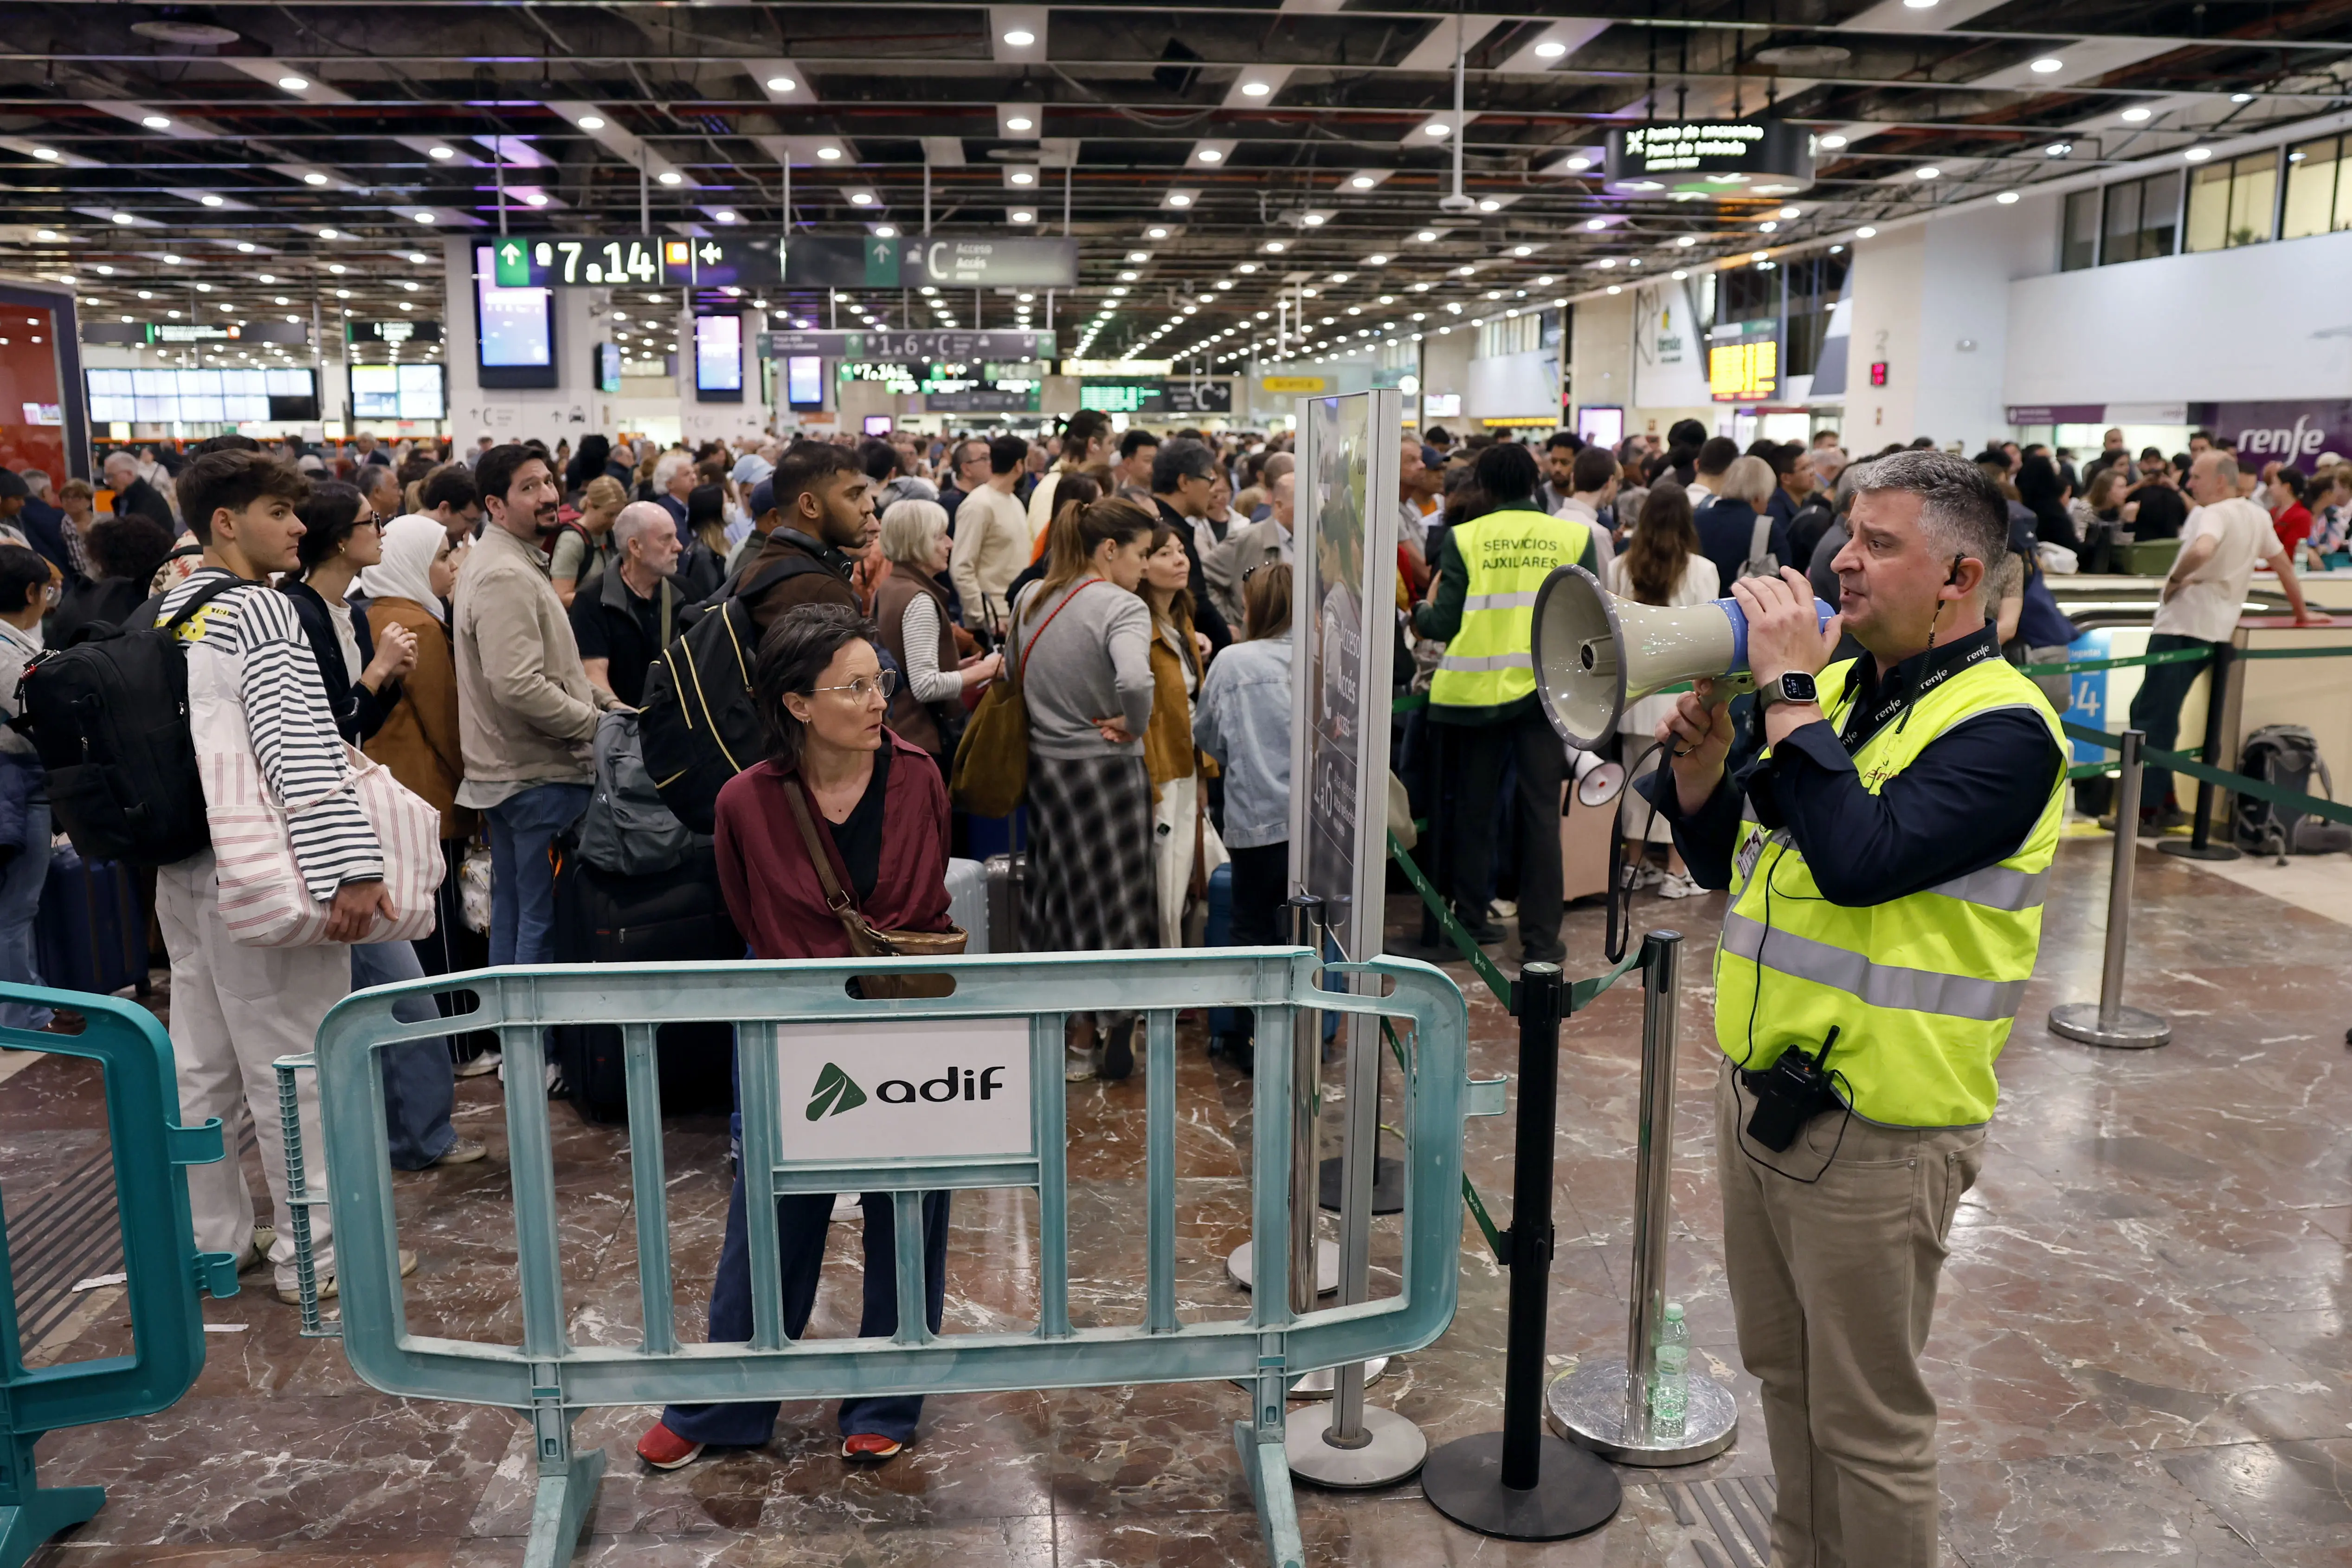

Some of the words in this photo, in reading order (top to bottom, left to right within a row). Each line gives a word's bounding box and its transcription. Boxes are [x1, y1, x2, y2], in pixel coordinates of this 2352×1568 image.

[928, 242, 948, 280] C
[2237, 414, 2325, 468] renfe
[1484, 538, 1558, 551] SERVICIOS
[1482, 556, 1559, 570] AUXILARES
[1339, 620, 1360, 659] Acceso
[1967, 644, 1990, 662] renfe
[2071, 649, 2101, 658] legadas
[1338, 665, 1356, 704] Accés
[1920, 669, 1948, 690] renfe
[1875, 699, 1901, 721] renfe
[1842, 732, 1858, 745] nfe
[876, 1066, 1005, 1103] adif
